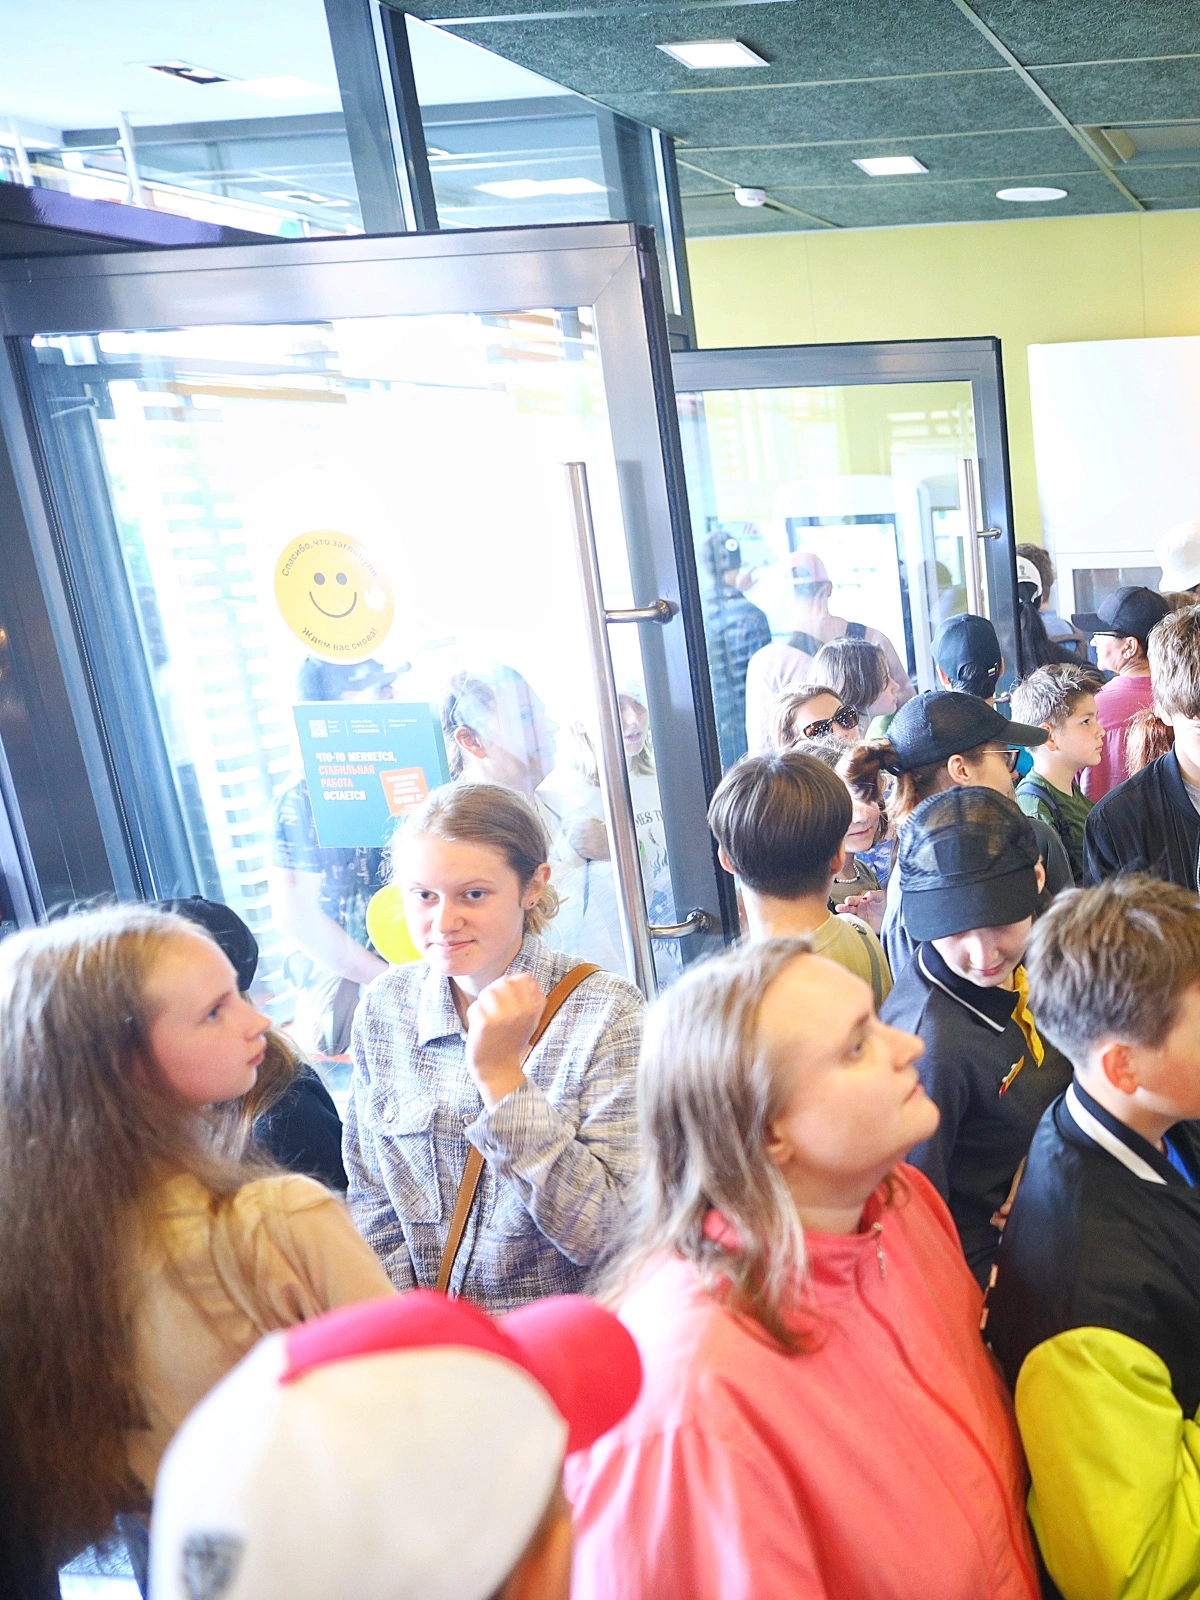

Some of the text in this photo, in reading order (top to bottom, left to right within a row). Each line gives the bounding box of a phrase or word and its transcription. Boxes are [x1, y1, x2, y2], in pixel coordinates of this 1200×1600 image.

[282, 543, 314, 577] Спасибо,
[302, 627, 331, 650] Ждем
[352, 627, 379, 650] снова!
[315, 751, 398, 764] ЧТО-ТО МЕНЯЕТСЯ,
[318, 765, 375, 775] СТАБИЛЬНАЯ
[321, 778, 354, 788] РАБОТА
[323, 790, 366, 801] ОСТАЕТСЯ
